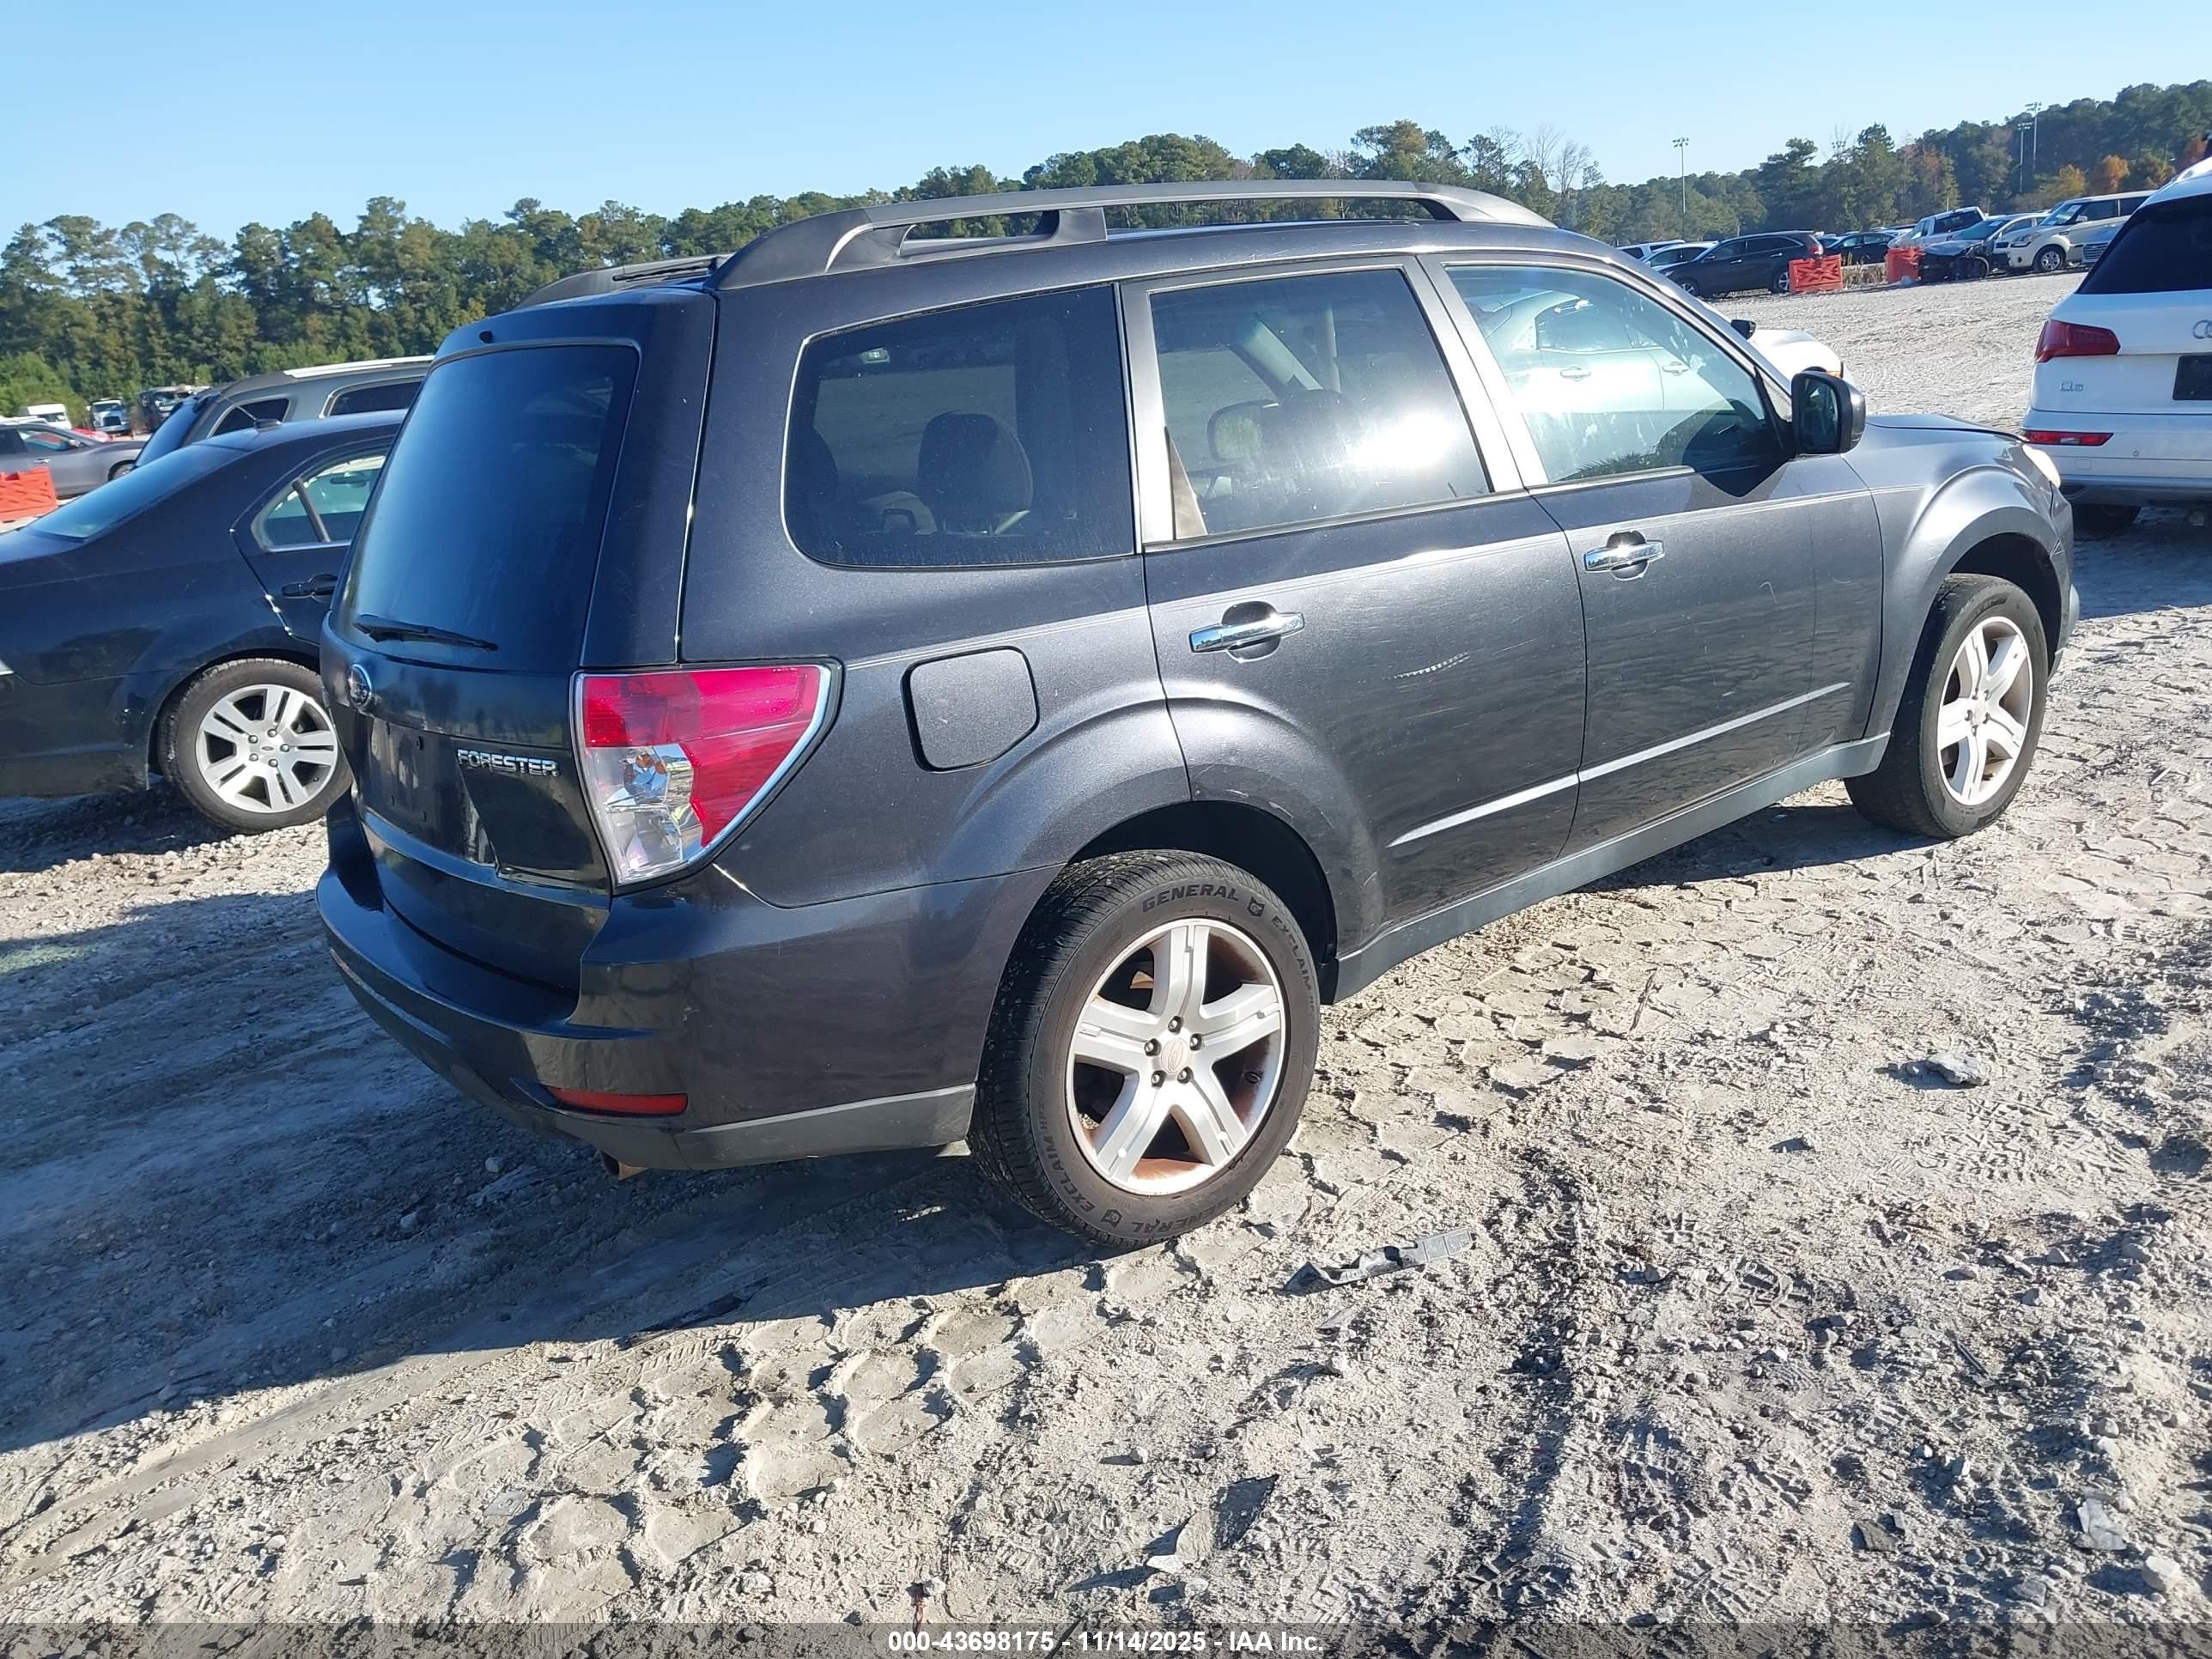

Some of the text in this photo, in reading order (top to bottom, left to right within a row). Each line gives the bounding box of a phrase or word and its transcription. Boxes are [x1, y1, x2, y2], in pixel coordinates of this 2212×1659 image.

[457, 749, 562, 777] FORESTER
[1142, 884, 1313, 990] GENERAL EXCLAIM
[1042, 1135, 1097, 1213] EXCLAIM
